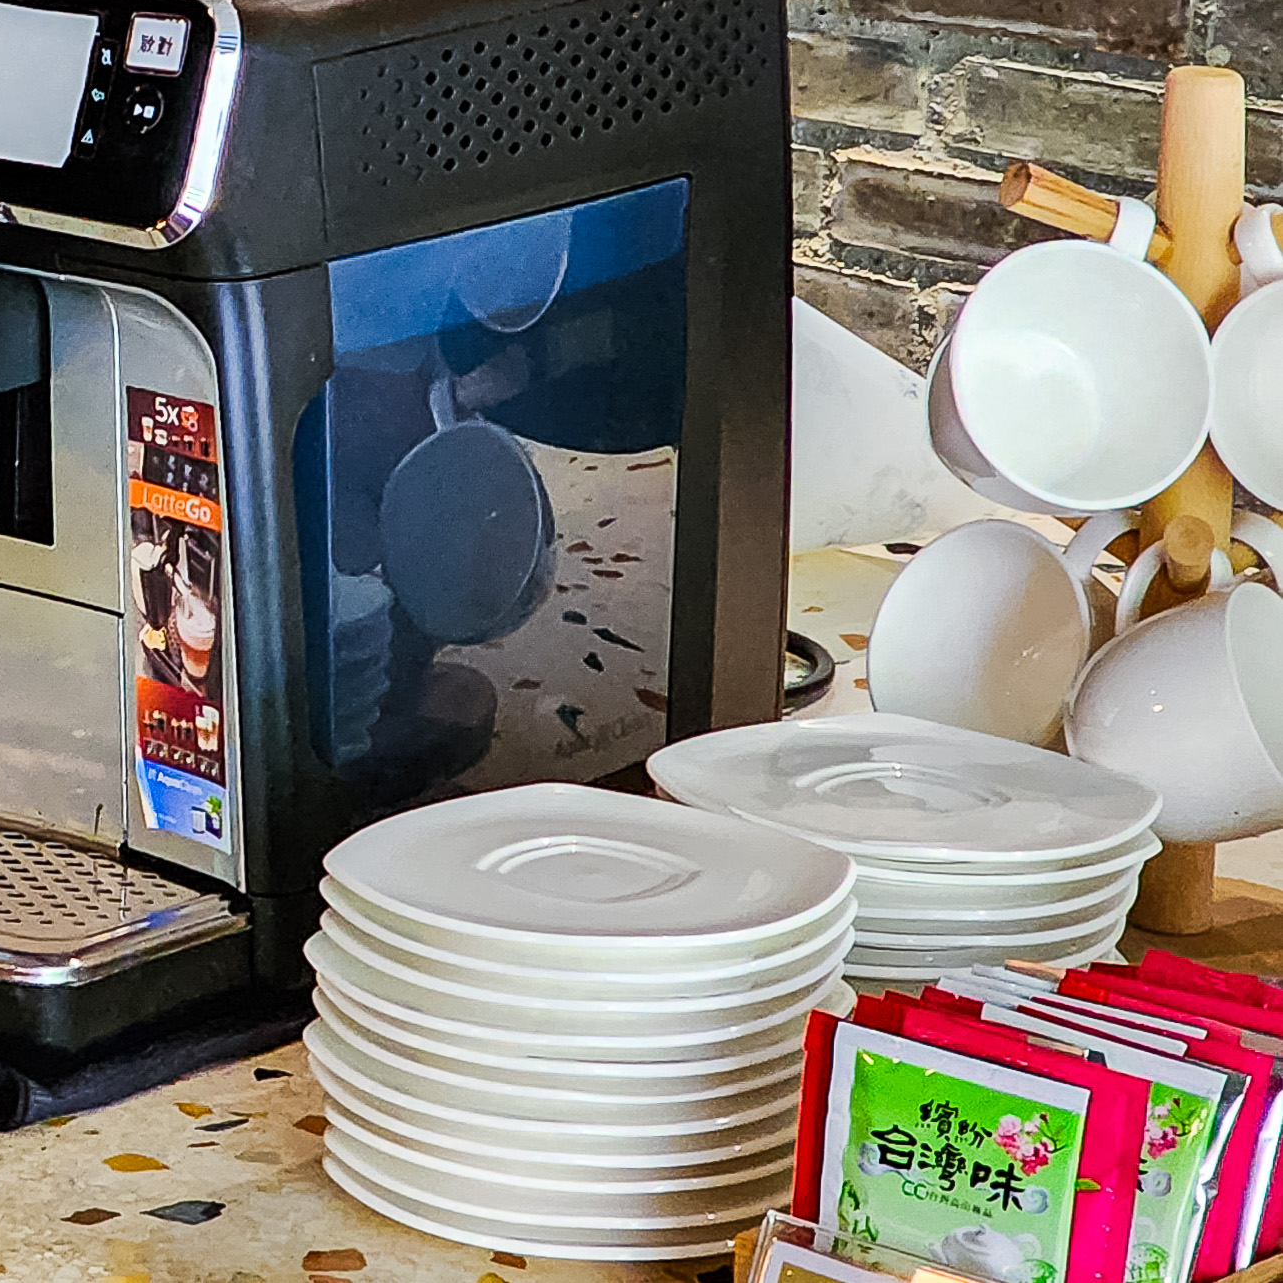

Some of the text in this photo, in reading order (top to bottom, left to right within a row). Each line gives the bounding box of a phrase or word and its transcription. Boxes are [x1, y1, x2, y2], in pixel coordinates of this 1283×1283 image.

[143, 486, 212, 524] LatteGo
[915, 1099, 993, 1149] 繽紛
[870, 1124, 1026, 1212] 台灣味
